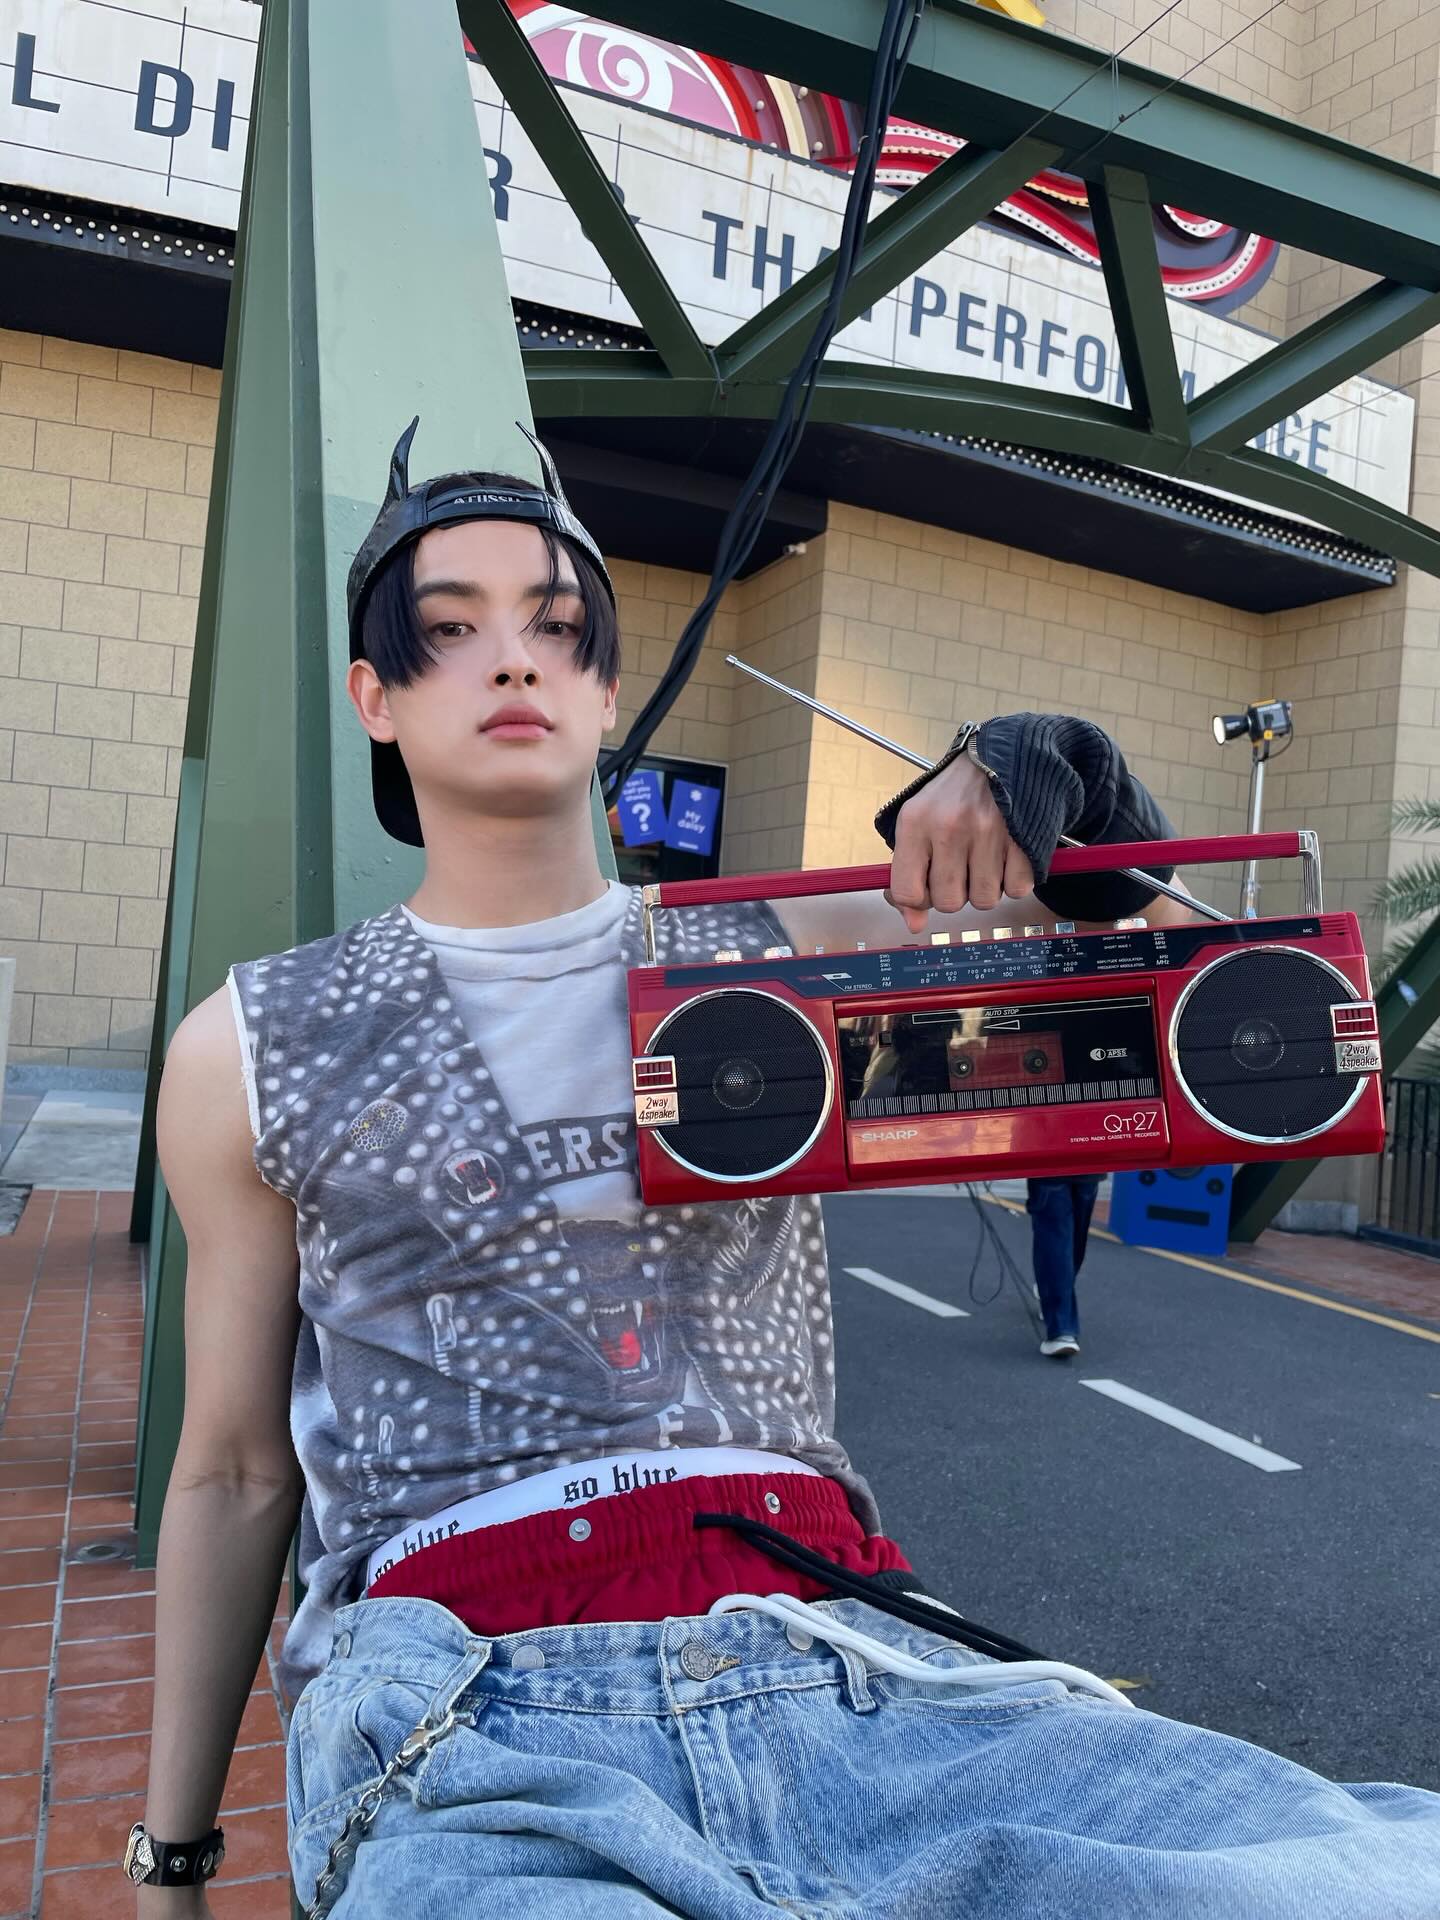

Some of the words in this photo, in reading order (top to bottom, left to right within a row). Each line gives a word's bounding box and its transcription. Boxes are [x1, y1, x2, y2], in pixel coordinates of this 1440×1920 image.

[1340, 1056, 1378, 1069] 4speaker
[862, 1130, 918, 1143] SHARP
[521, 1121, 629, 1181] ERS
[563, 1477, 598, 1504] so
[612, 1461, 679, 1493] blue
